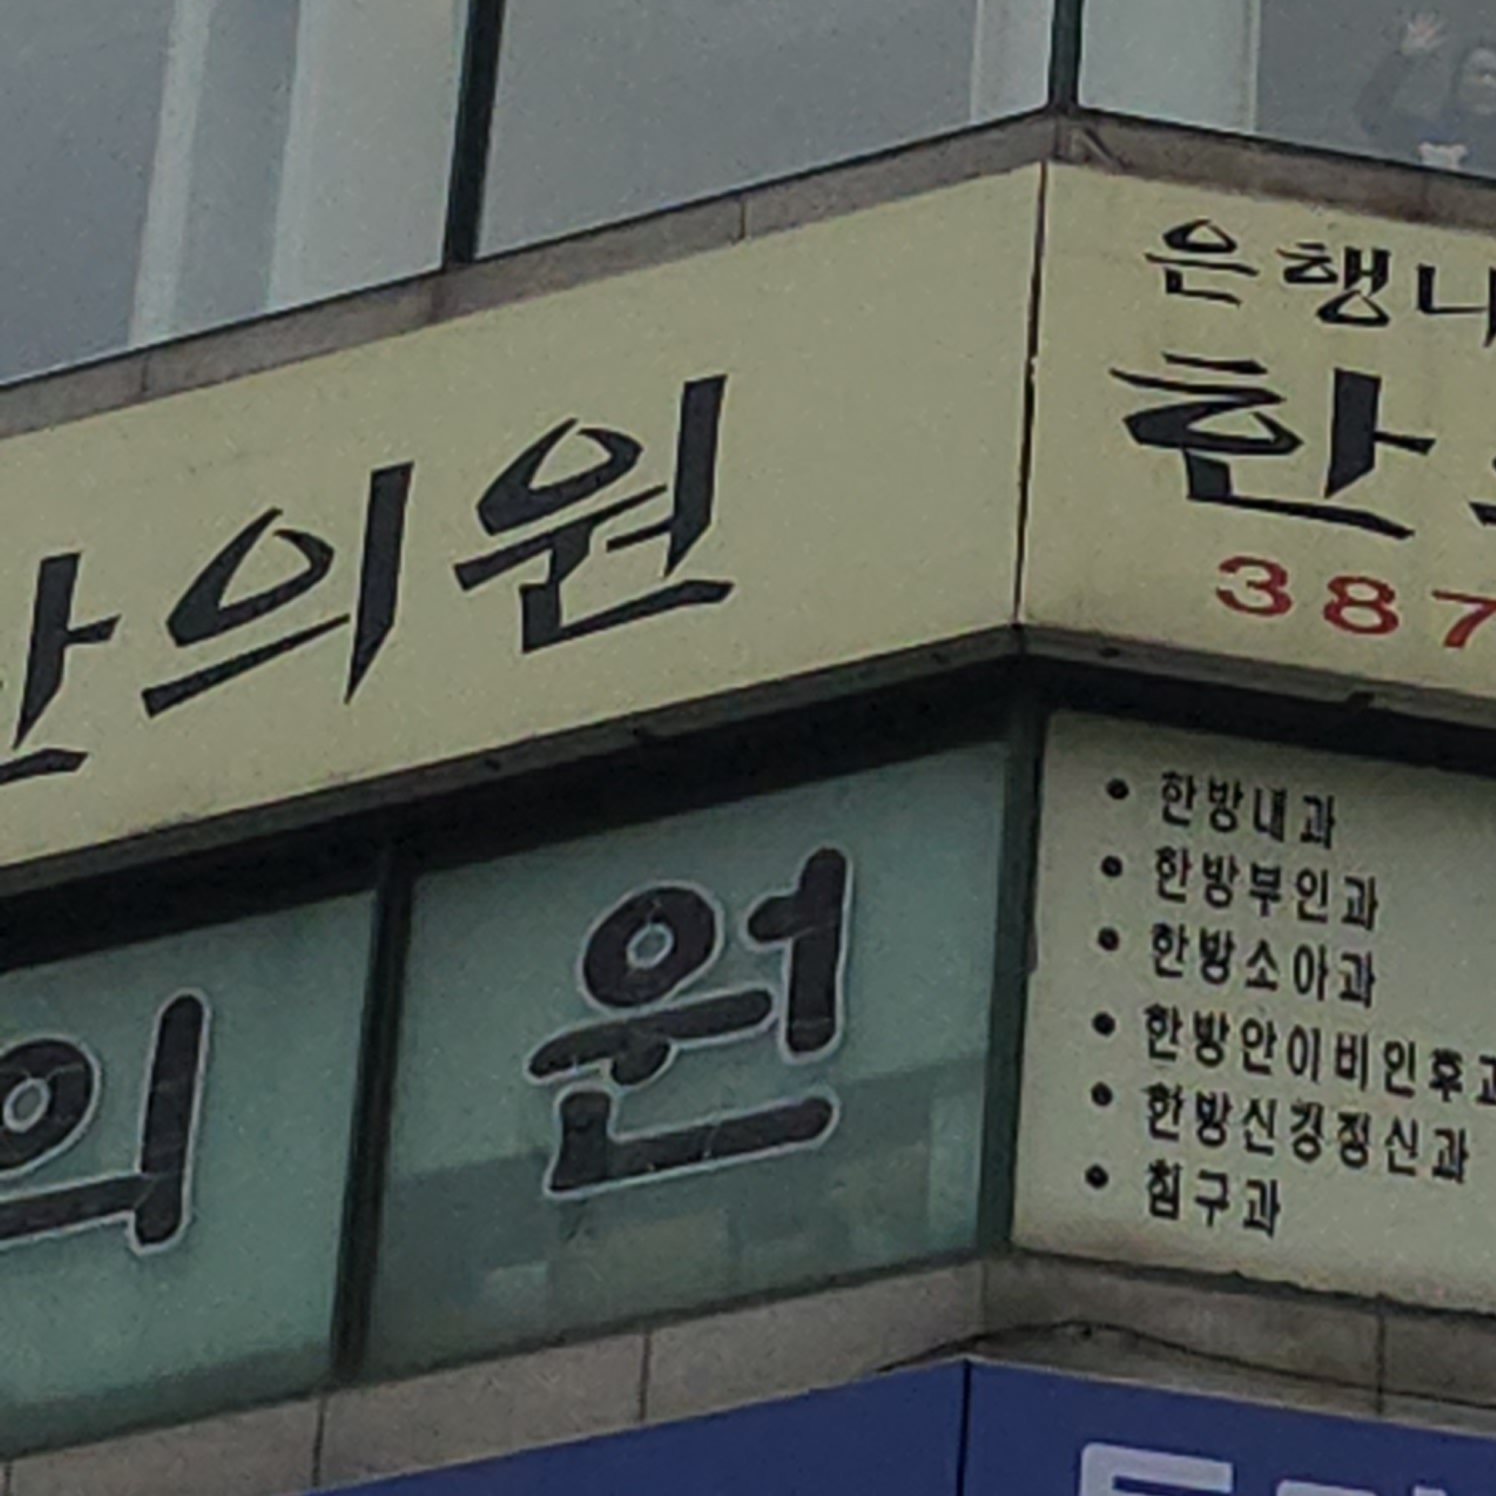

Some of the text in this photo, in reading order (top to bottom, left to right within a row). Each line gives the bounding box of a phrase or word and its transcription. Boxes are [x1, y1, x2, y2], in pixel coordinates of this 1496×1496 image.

[1161, 771, 1336, 849] 한방내과
[1155, 846, 1379, 931] 한방부인과
[1151, 923, 1375, 1008] 한방소아과
[1143, 1082, 1469, 1184] 한방신경정신과
[1147, 1159, 1281, 1238] 침구과
